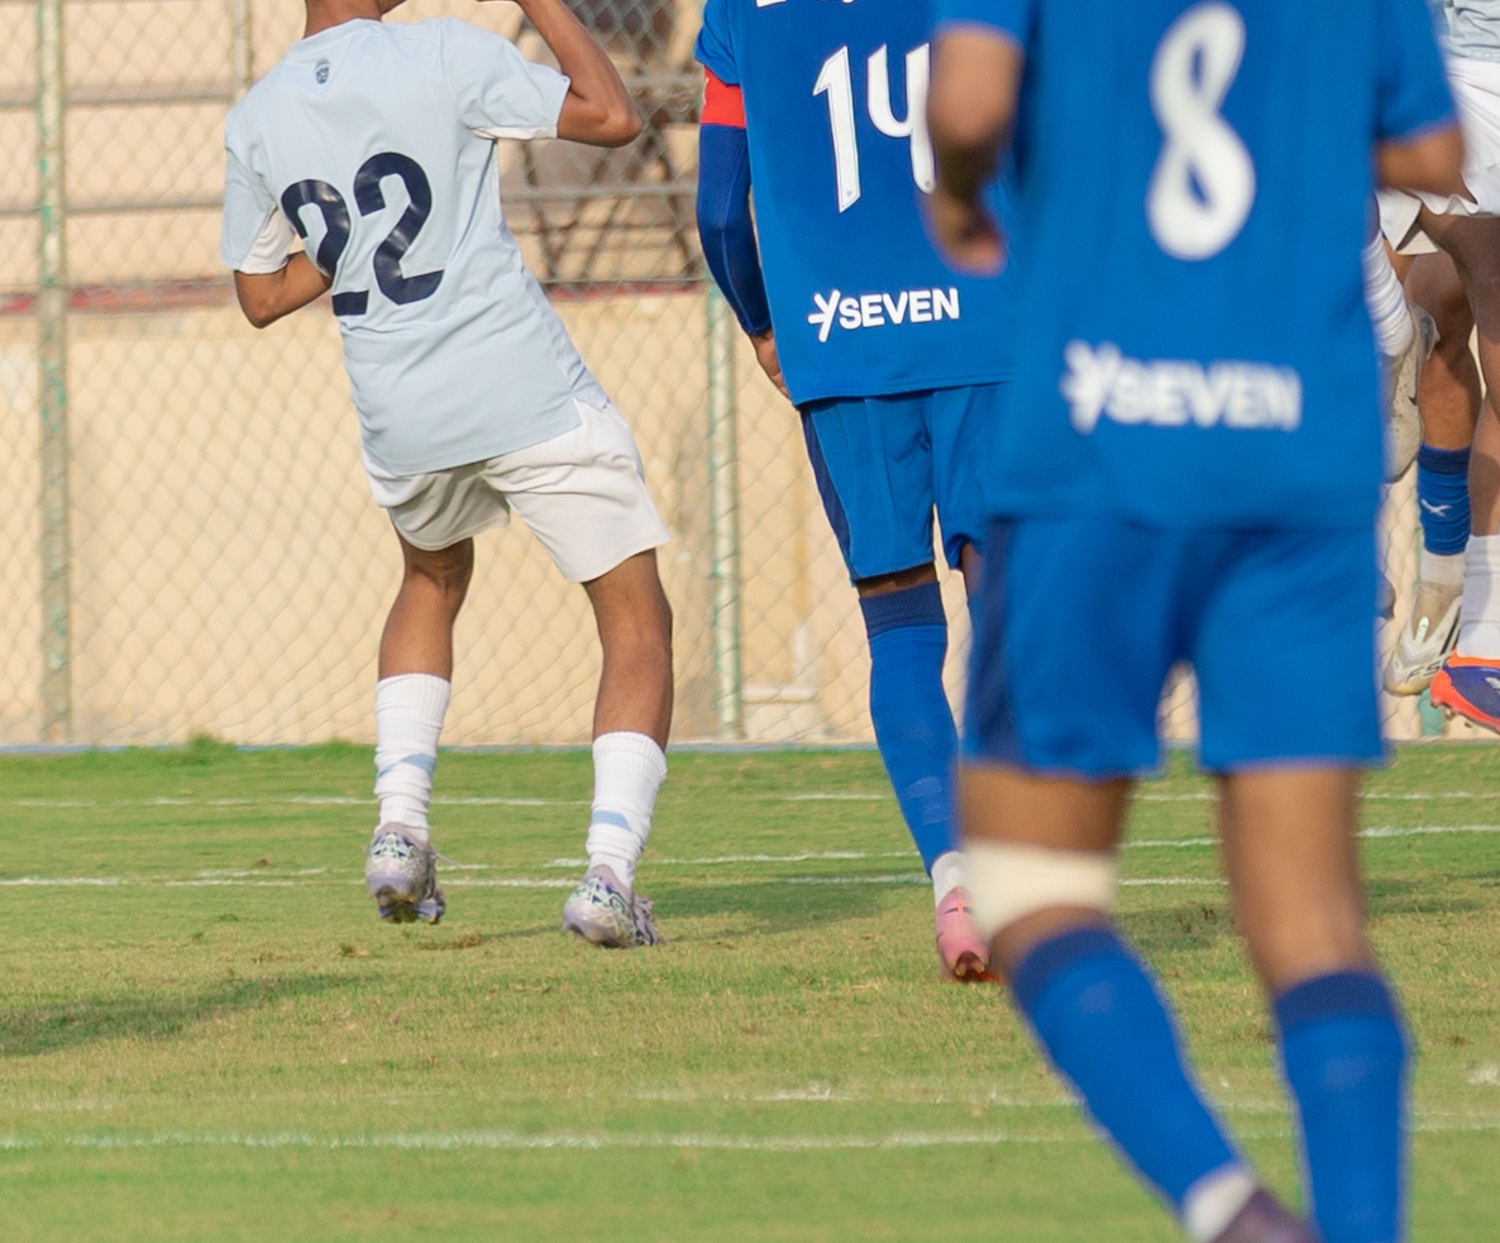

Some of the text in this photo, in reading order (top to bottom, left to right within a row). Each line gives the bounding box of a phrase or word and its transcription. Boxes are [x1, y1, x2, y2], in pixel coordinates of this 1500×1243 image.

[812, 42, 937, 214] 14
[1145, 0, 1257, 262] 8
[280, 151, 446, 317] 22
